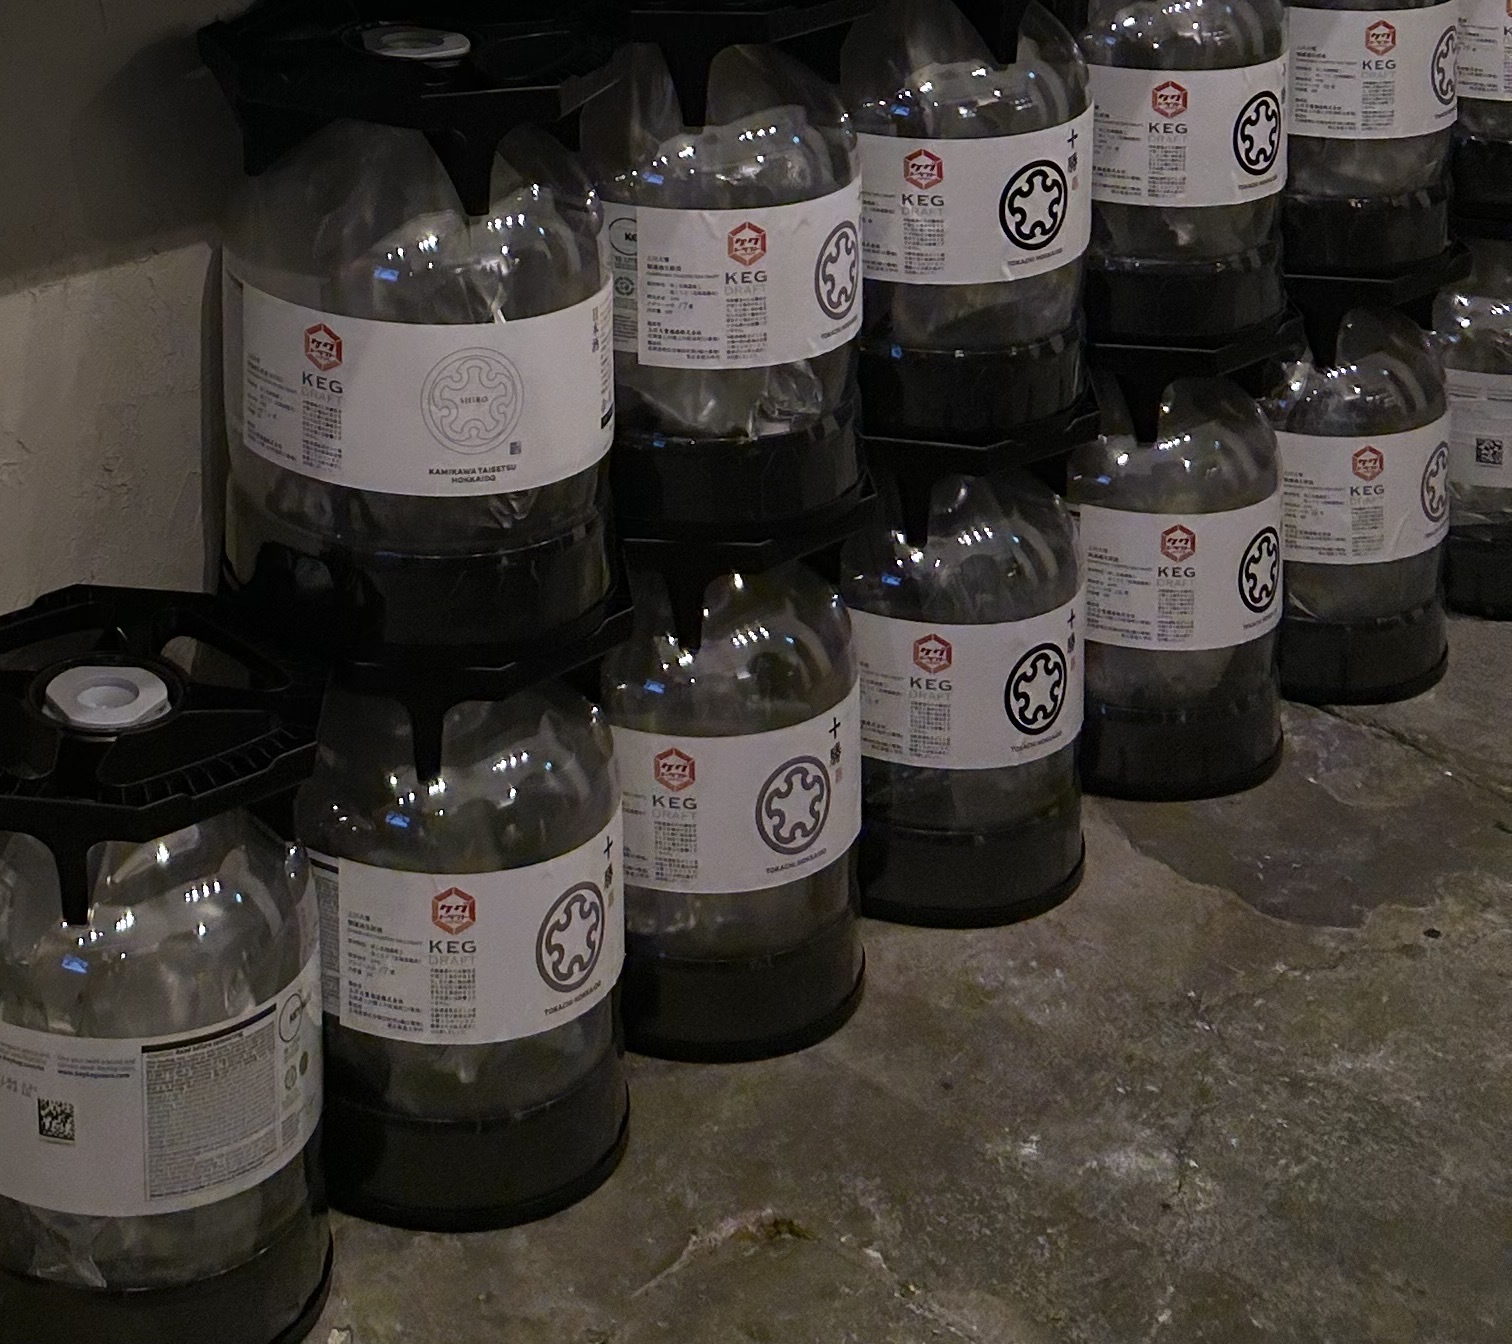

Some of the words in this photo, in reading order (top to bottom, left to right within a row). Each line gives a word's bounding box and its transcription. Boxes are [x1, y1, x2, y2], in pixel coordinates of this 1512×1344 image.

[1362, 59, 1396, 71] KEG
[1148, 122, 1188, 134] KEG
[901, 193, 945, 207] KEG
[725, 270, 768, 285] KEG
[302, 371, 344, 394] KEG
[428, 467, 477, 476] KAMIKAWA
[478, 464, 517, 474] TAISETSU
[451, 474, 497, 484] HOKKAIDO
[1350, 484, 1385, 497] KEG
[1157, 566, 1196, 578] KEG
[910, 676, 953, 691] KEG
[652, 794, 698, 810] KEG
[429, 939, 477, 954] KEG
